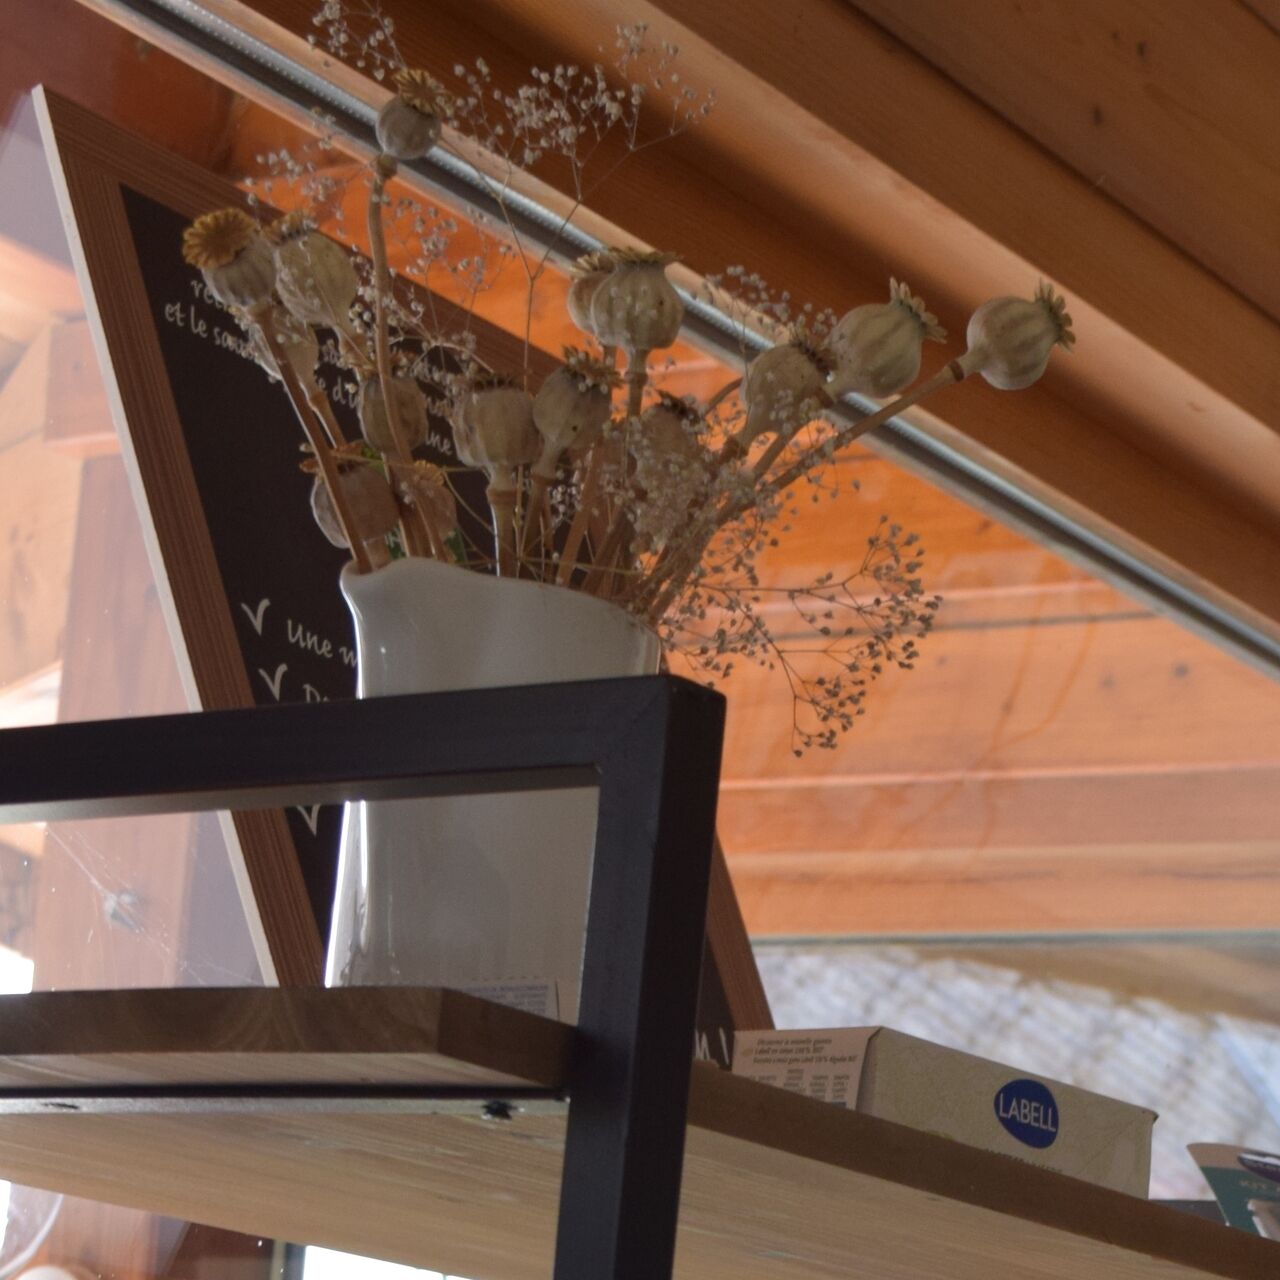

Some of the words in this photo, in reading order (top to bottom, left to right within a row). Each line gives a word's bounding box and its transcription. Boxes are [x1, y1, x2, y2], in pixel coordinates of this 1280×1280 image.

[164, 301, 186, 327] et
[190, 304, 209, 338] le
[287, 617, 334, 659] Une
[999, 1092, 1056, 1132] LABELL
